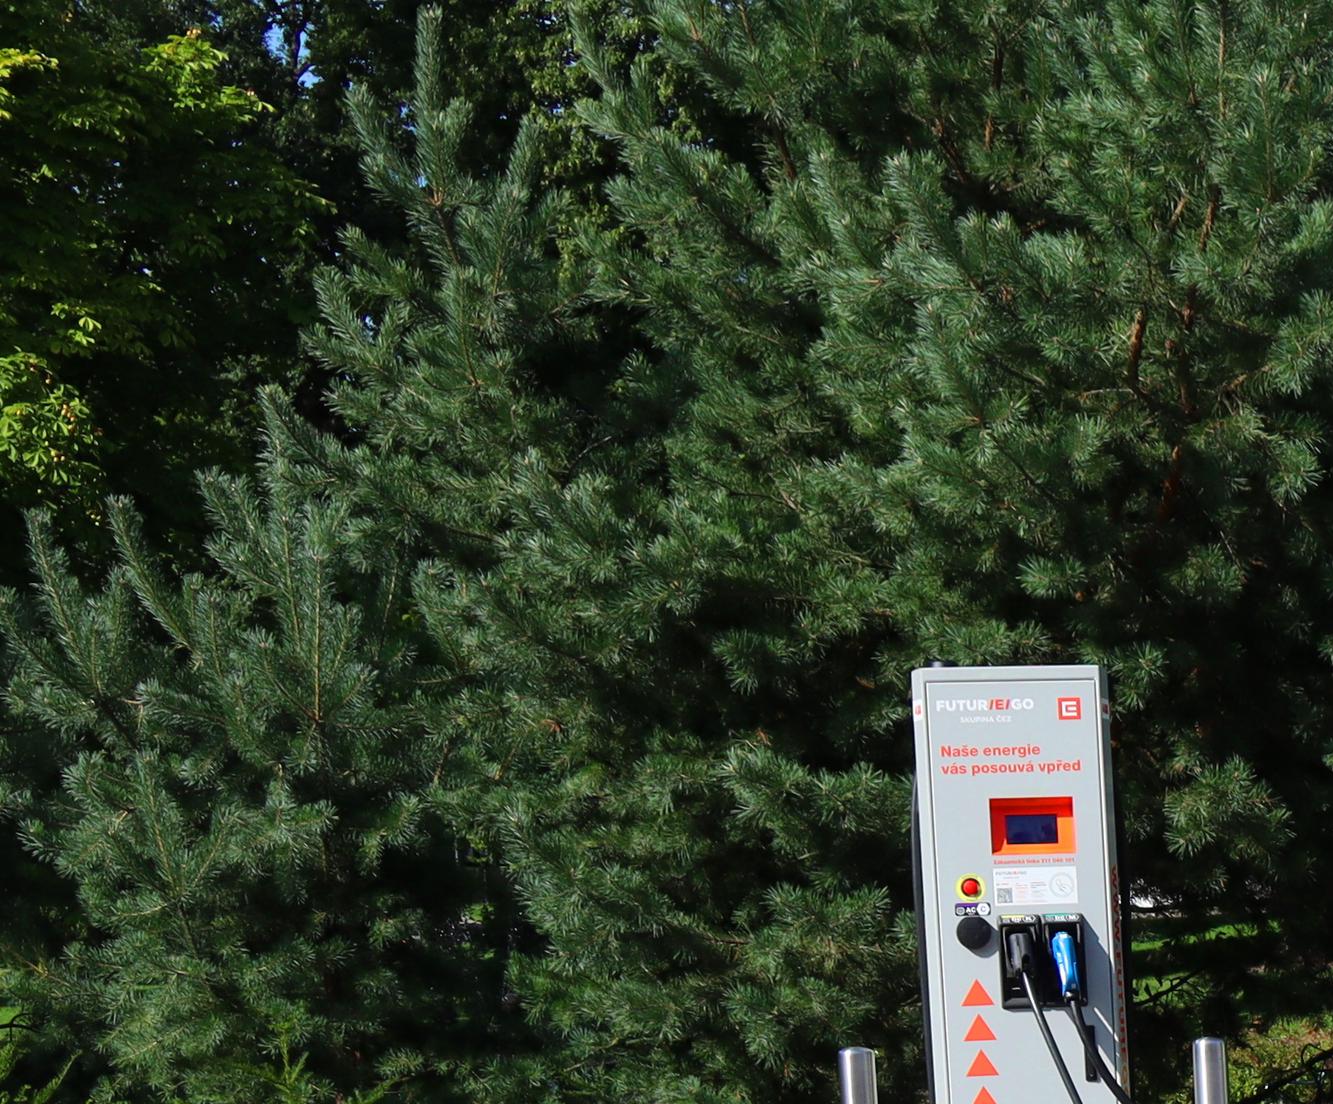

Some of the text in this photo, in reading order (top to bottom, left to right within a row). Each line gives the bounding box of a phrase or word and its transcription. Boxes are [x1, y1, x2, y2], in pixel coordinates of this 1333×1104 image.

[941, 743, 1041, 757] Naše energie
[941, 759, 1081, 776] vás posouvá vpřed
